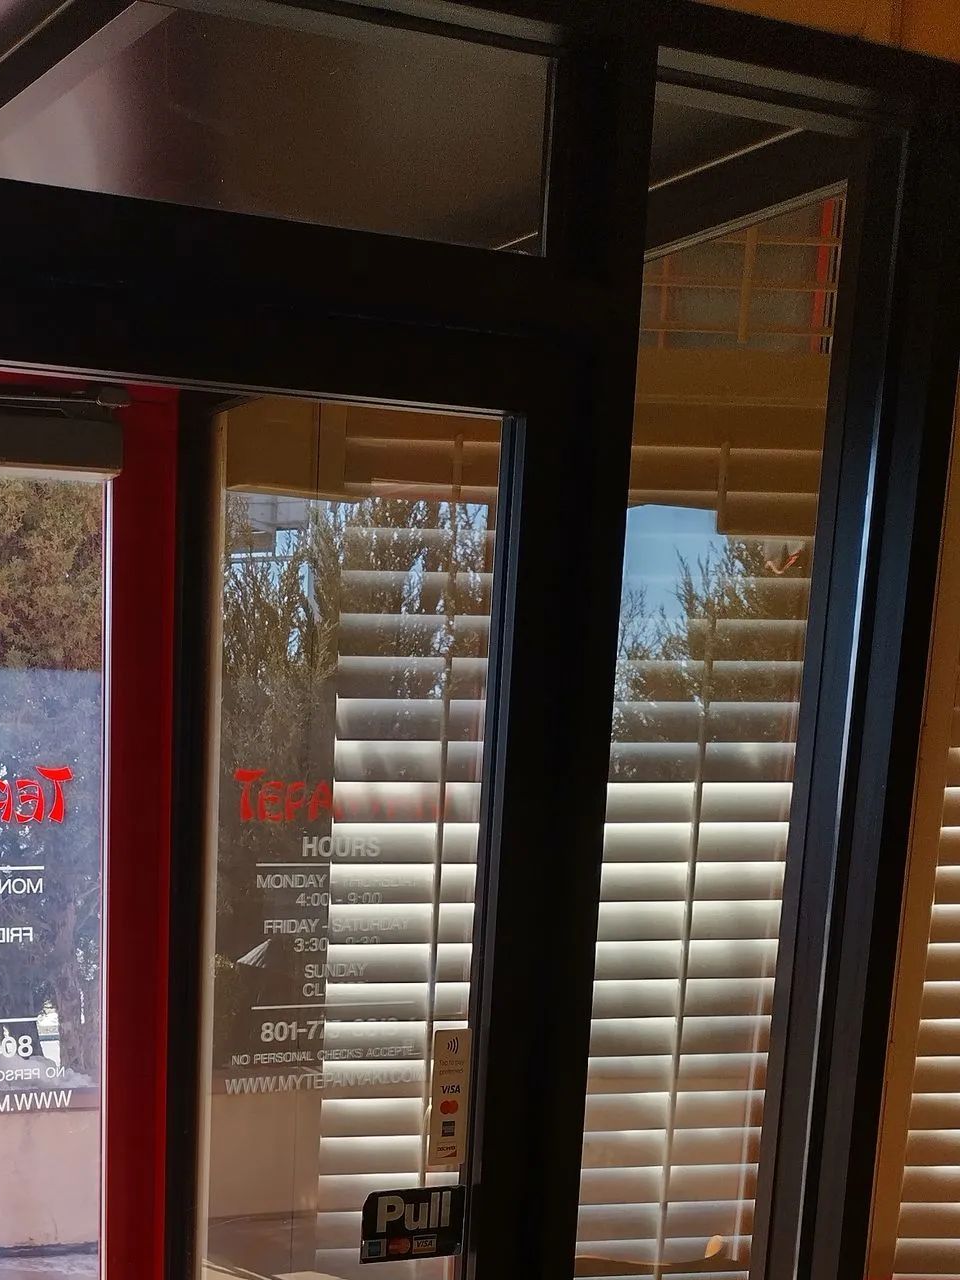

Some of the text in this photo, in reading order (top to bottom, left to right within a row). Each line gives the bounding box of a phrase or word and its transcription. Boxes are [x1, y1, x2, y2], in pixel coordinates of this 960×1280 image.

[302, 836, 381, 857] HOURS
[257, 874, 327, 889] MONDAY
[295, 892, 330, 907] 4:00
[263, 919, 320, 935] FRIDAY
[293, 937, 329, 952] 3:30
[304, 963, 369, 979] SUNDAY
[231, 1053, 251, 1066] NO
[253, 1051, 315, 1065] PERSONAL
[317, 1048, 364, 1061] CHECKS
[440, 1085, 461, 1094] VISA
[376, 1190, 452, 1233] Pull
[416, 1239, 433, 1248] VISA
